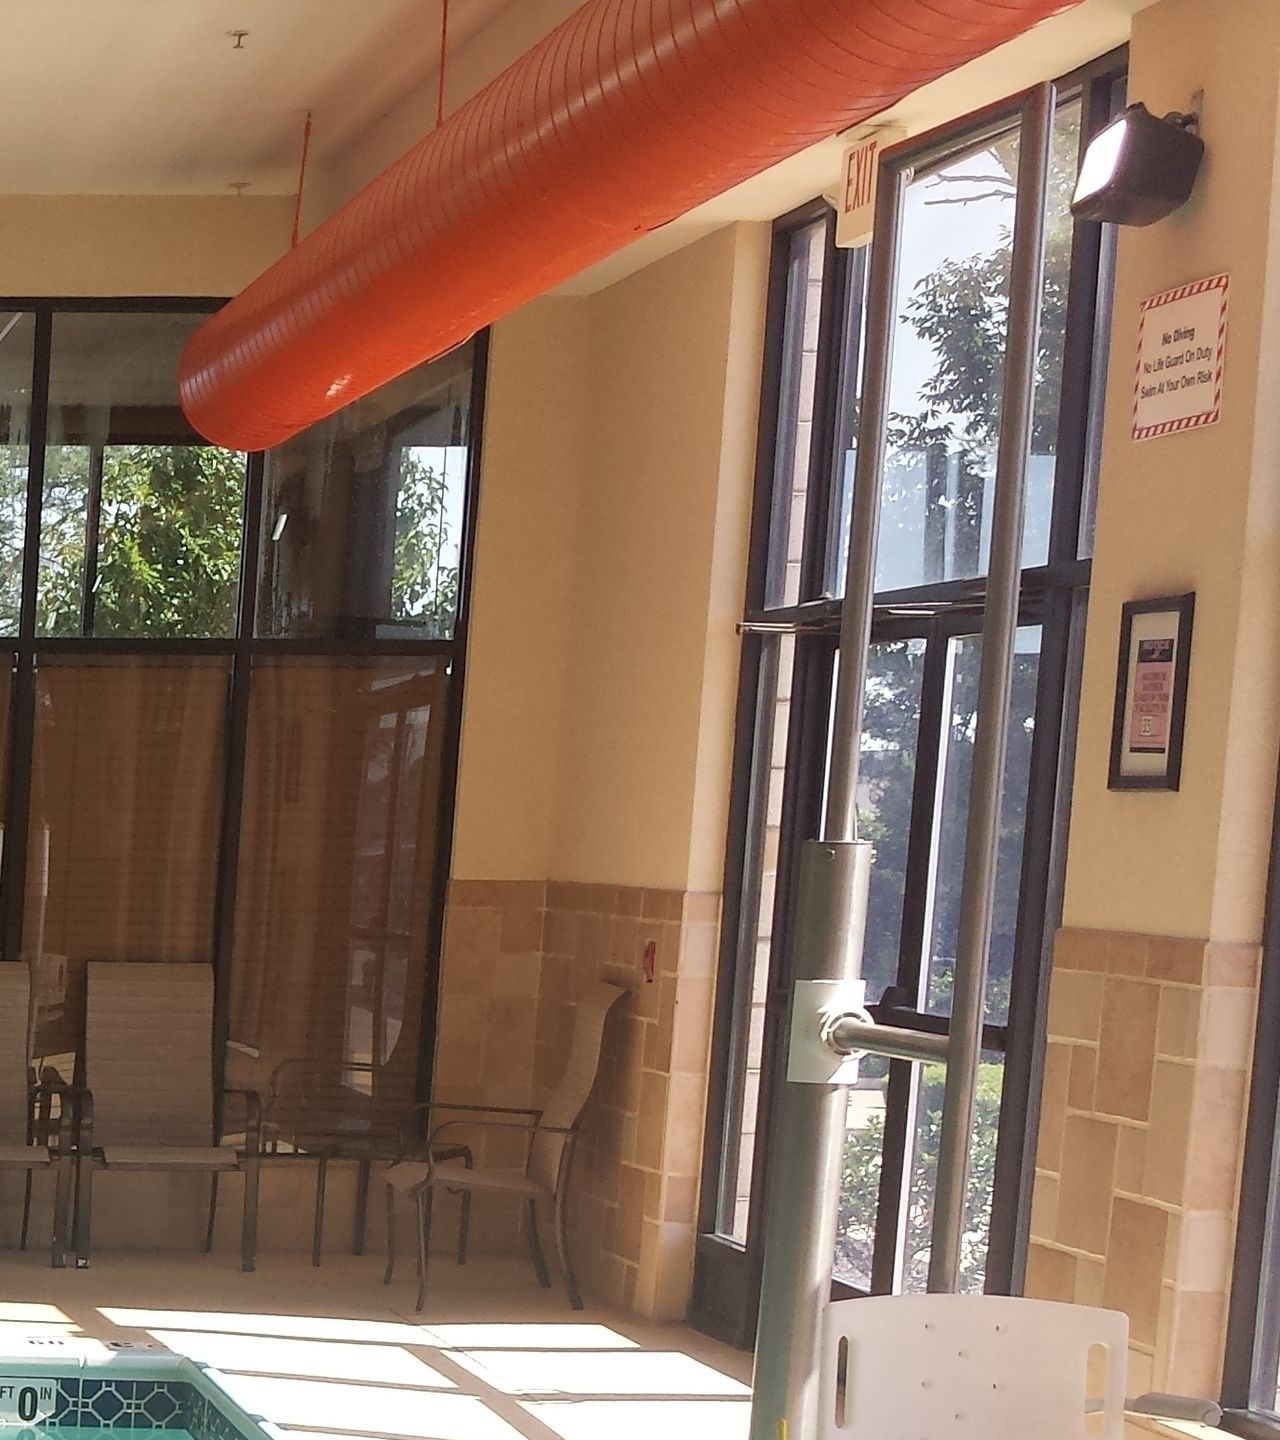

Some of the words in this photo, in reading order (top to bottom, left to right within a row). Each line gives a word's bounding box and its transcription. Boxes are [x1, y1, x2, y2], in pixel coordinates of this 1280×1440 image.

[845, 140, 877, 214] EXIT
[1162, 333, 1171, 346] No
[1174, 327, 1195, 342] Diving
[1144, 362, 1152, 374] No
[1153, 359, 1163, 372] Life
[1165, 355, 1184, 369] Guard
[1185, 351, 1195, 363] On
[1197, 347, 1212, 362] Duty
[1141, 386, 1156, 399] Swim
[1158, 382, 1164, 393] At
[1166, 378, 1179, 392] Your
[1181, 375, 1195, 389] Own
[1197, 370, 1212, 384] Risk
